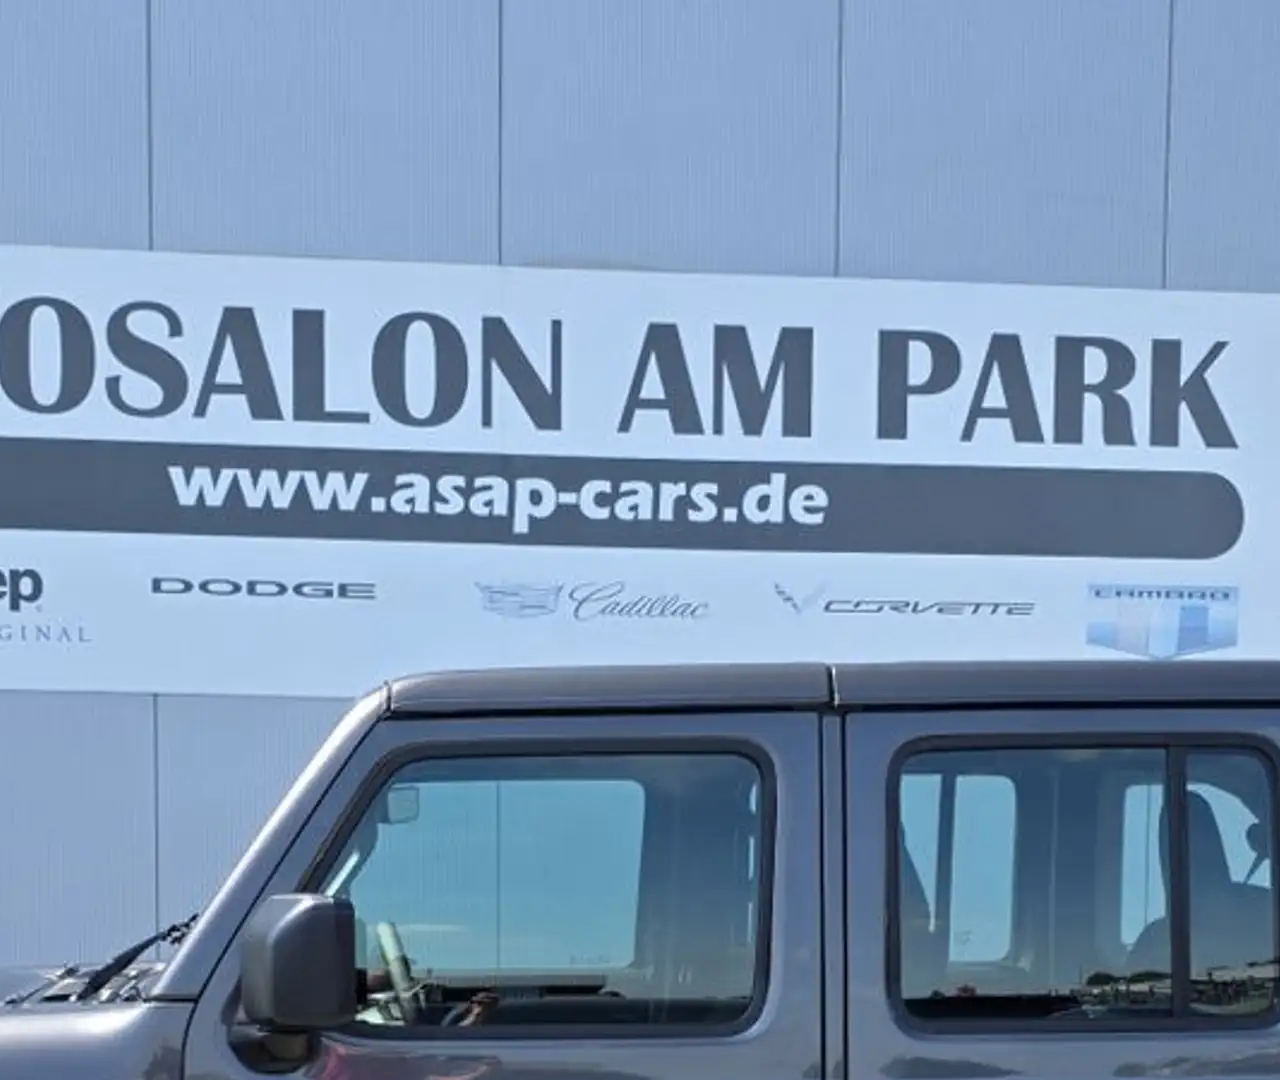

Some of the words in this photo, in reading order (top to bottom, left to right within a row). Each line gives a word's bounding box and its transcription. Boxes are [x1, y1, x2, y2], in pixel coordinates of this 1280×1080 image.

[617, 322, 814, 438] AM
[877, 328, 1239, 450] PARK
[168, 466, 829, 534] www.asap-cars.de
[152, 577, 376, 600] DODGE
[568, 581, 709, 621] Cadillac
[822, 599, 1036, 616] CORVETTE
